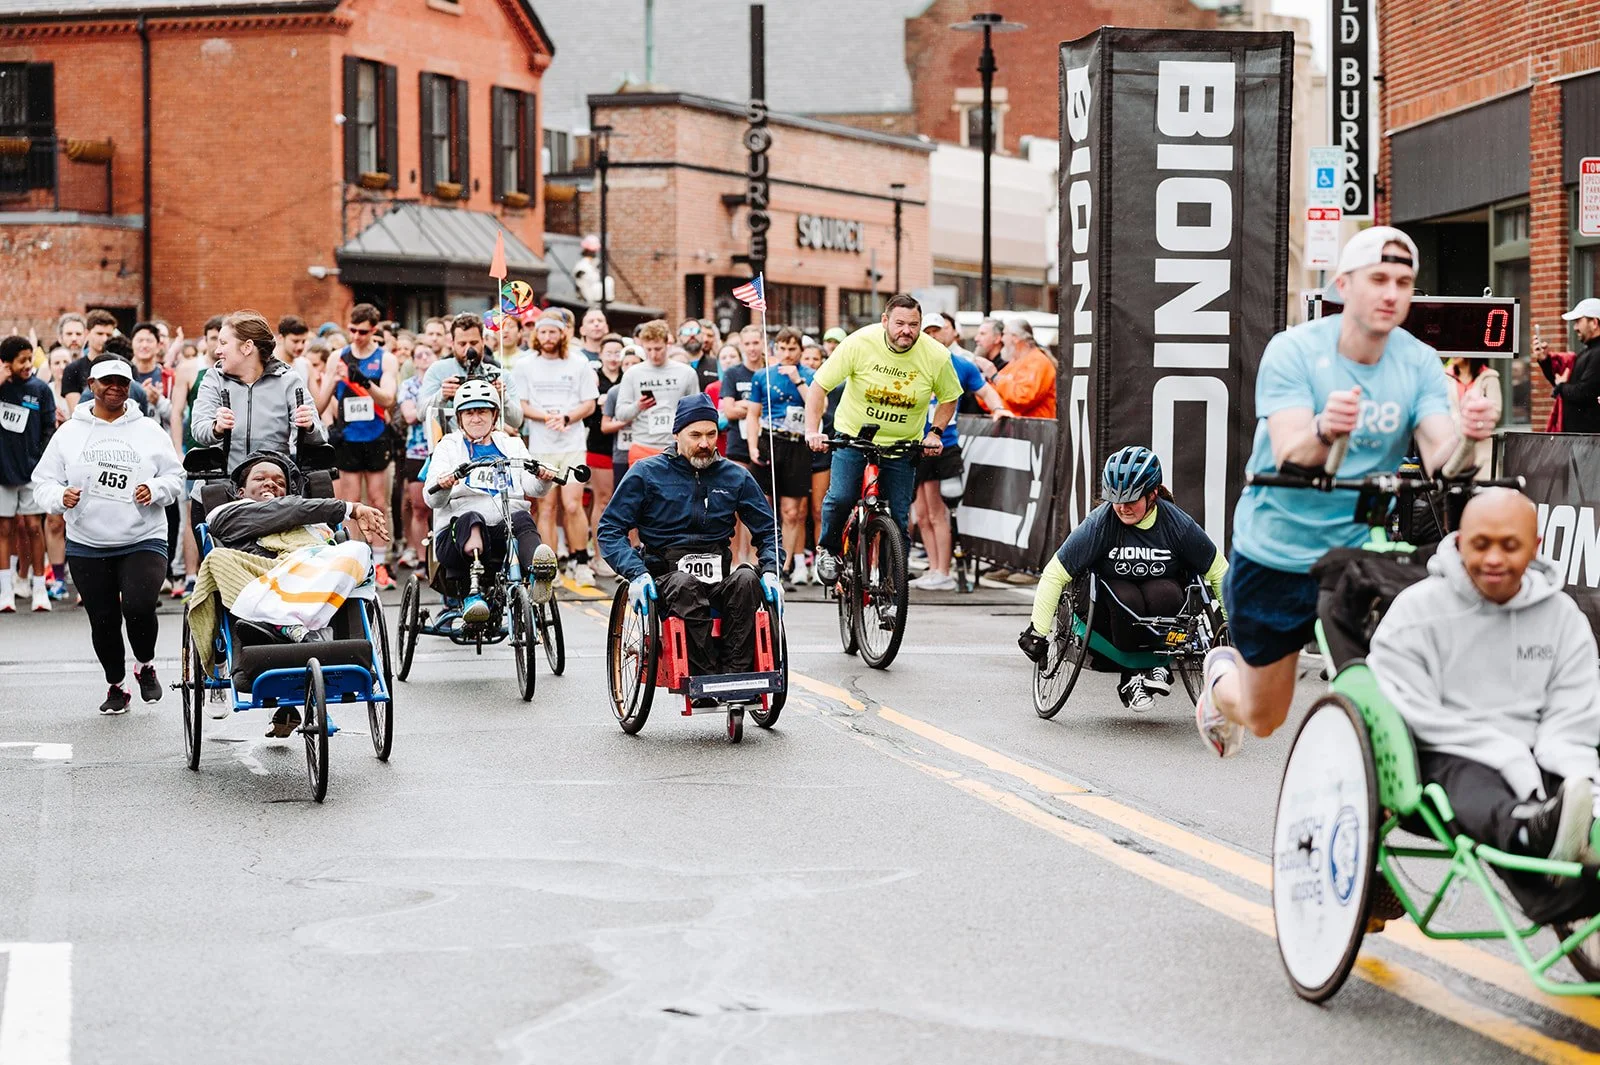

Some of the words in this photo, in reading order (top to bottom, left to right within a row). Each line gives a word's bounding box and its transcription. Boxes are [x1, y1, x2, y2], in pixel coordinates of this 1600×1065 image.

[1340, 57, 1362, 212] BURRO
[743, 99, 769, 260] SOURCE
[1066, 66, 1092, 530] BIONIC
[1151, 61, 1236, 555] BIONIC
[1484, 309, 1509, 347] 0
[872, 364, 907, 378] Achilles
[866, 406, 908, 424] GUIDE
[1357, 400, 1401, 434] R8
[98, 471, 128, 490] 453
[685, 562, 713, 578] 290
